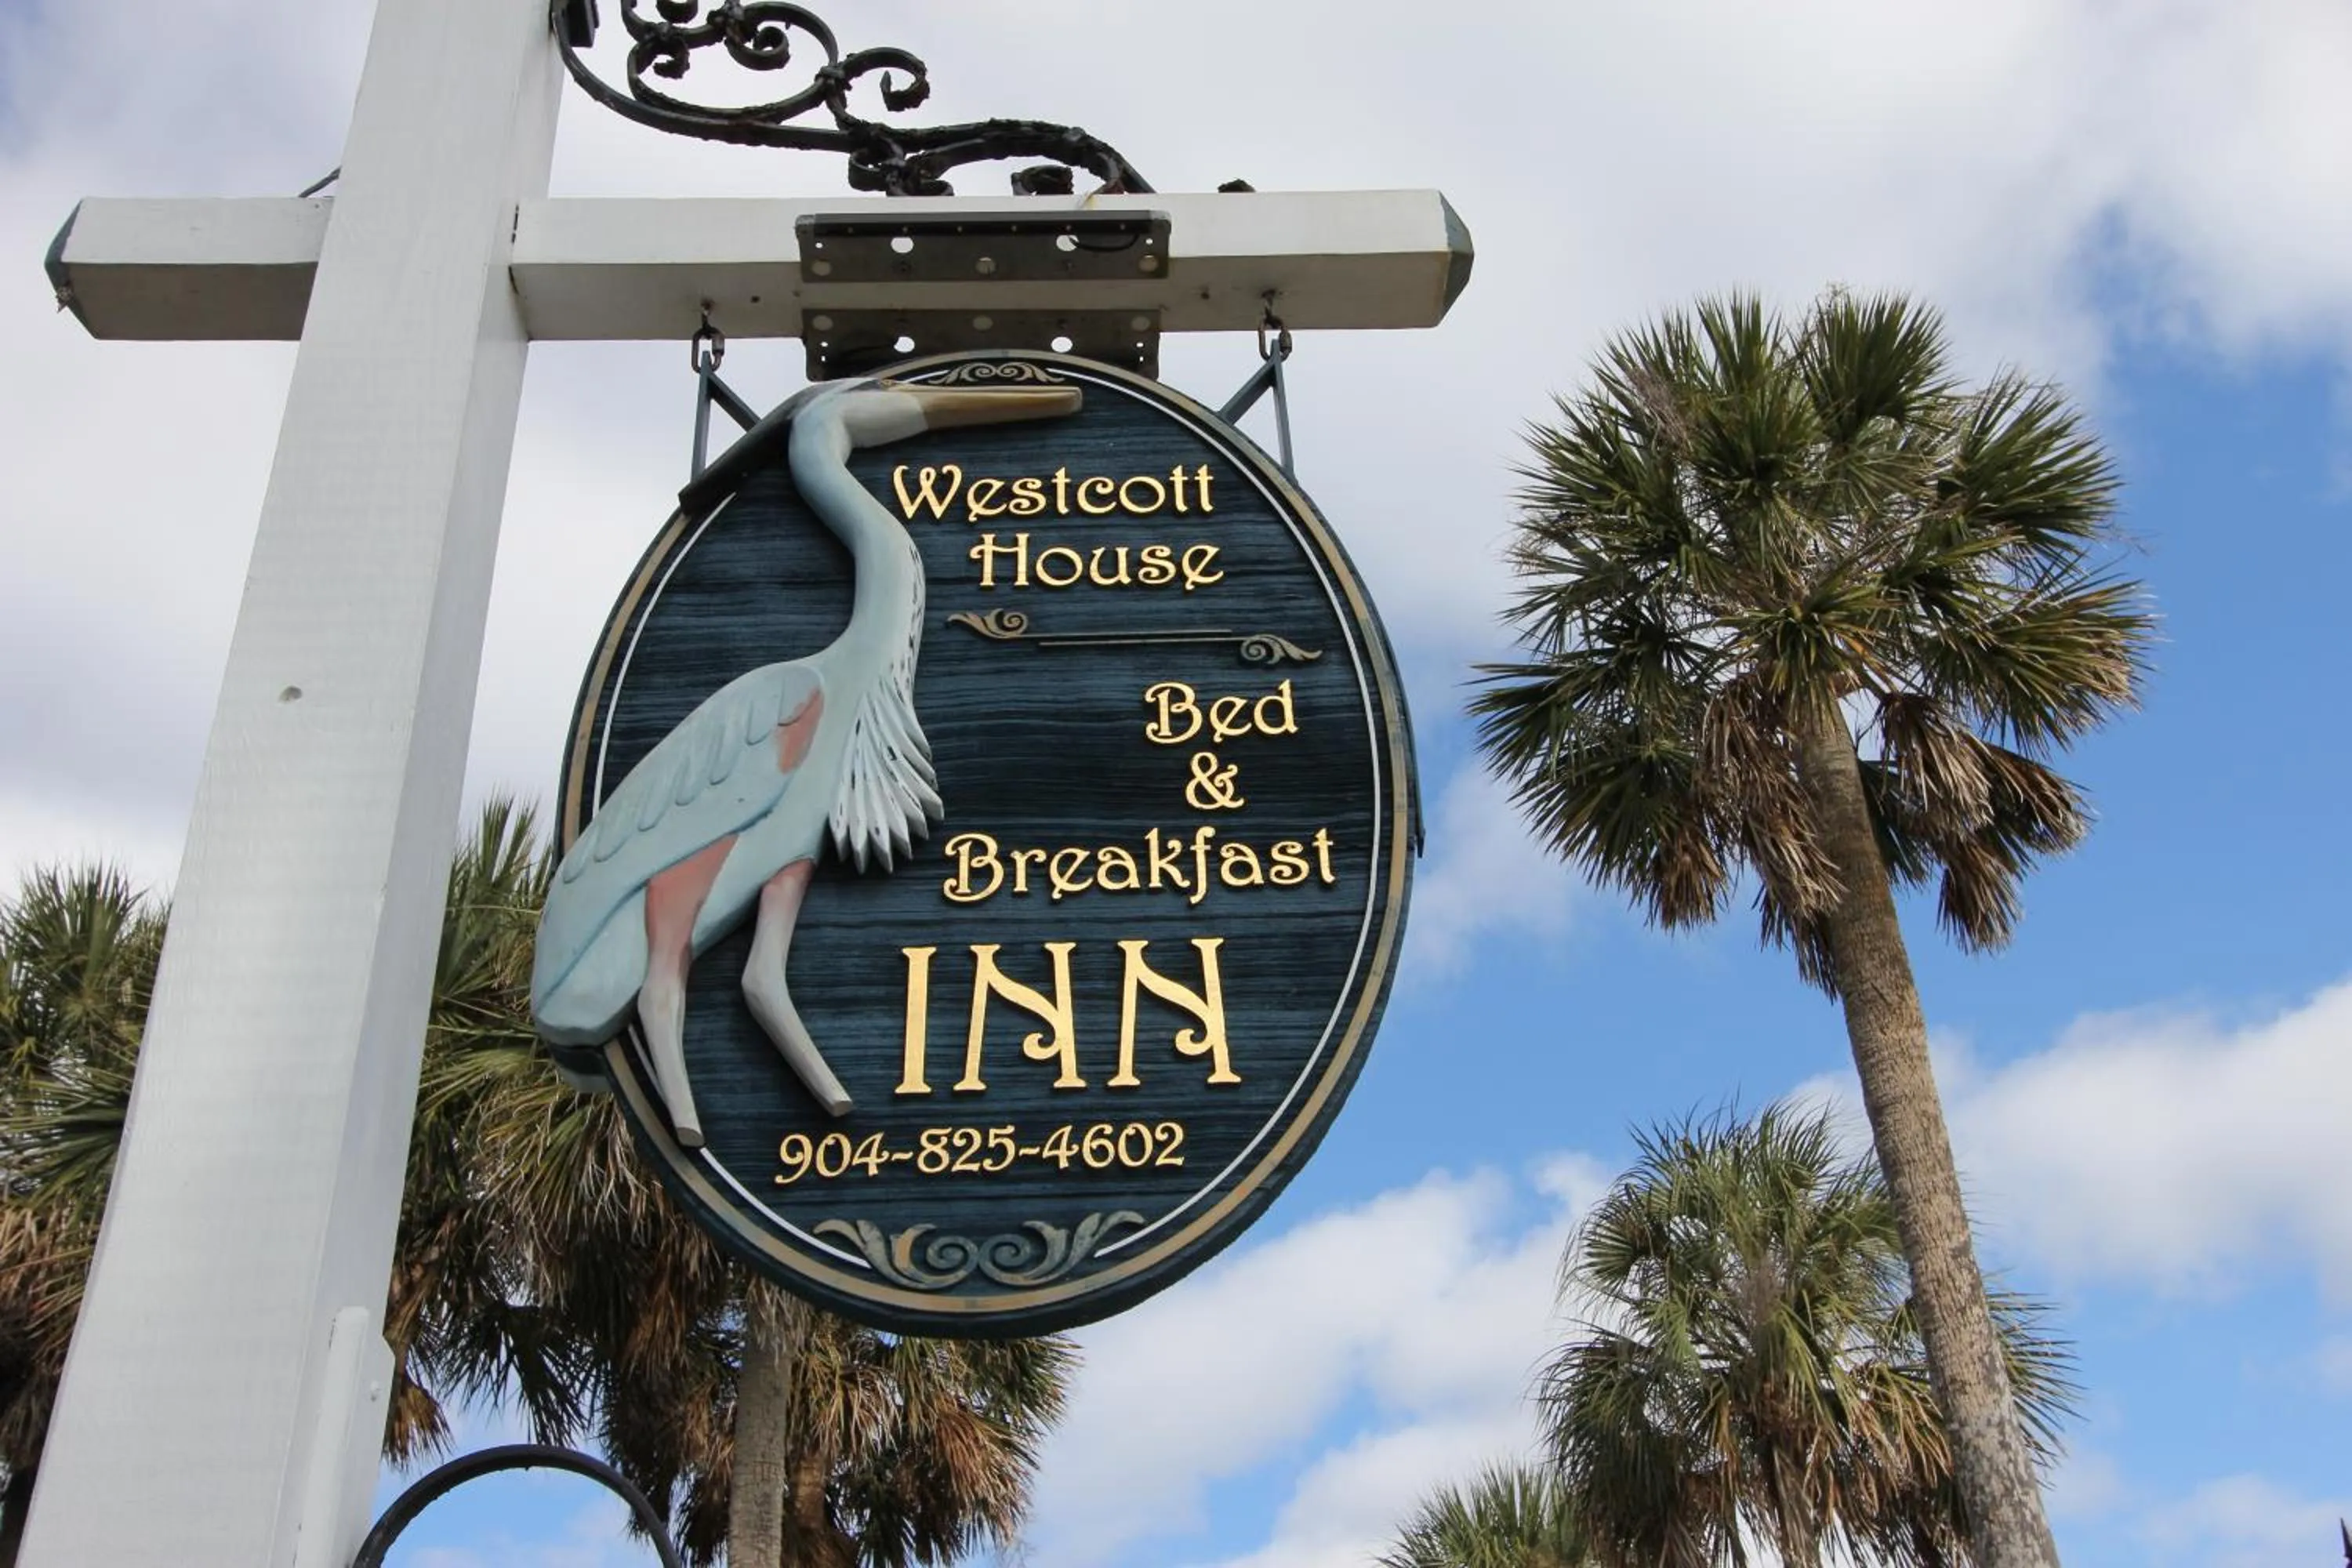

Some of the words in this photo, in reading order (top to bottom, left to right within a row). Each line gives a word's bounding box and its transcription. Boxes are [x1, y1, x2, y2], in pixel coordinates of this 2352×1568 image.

[892, 463, 1215, 522] Westcott
[969, 532, 1225, 590] House
[1144, 679, 1298, 745] Bed
[1185, 750, 1244, 810] &
[942, 824, 1336, 904] Breakfast
[894, 937, 1242, 1094] INN
[774, 1121, 1185, 1185] 904-825-4602
